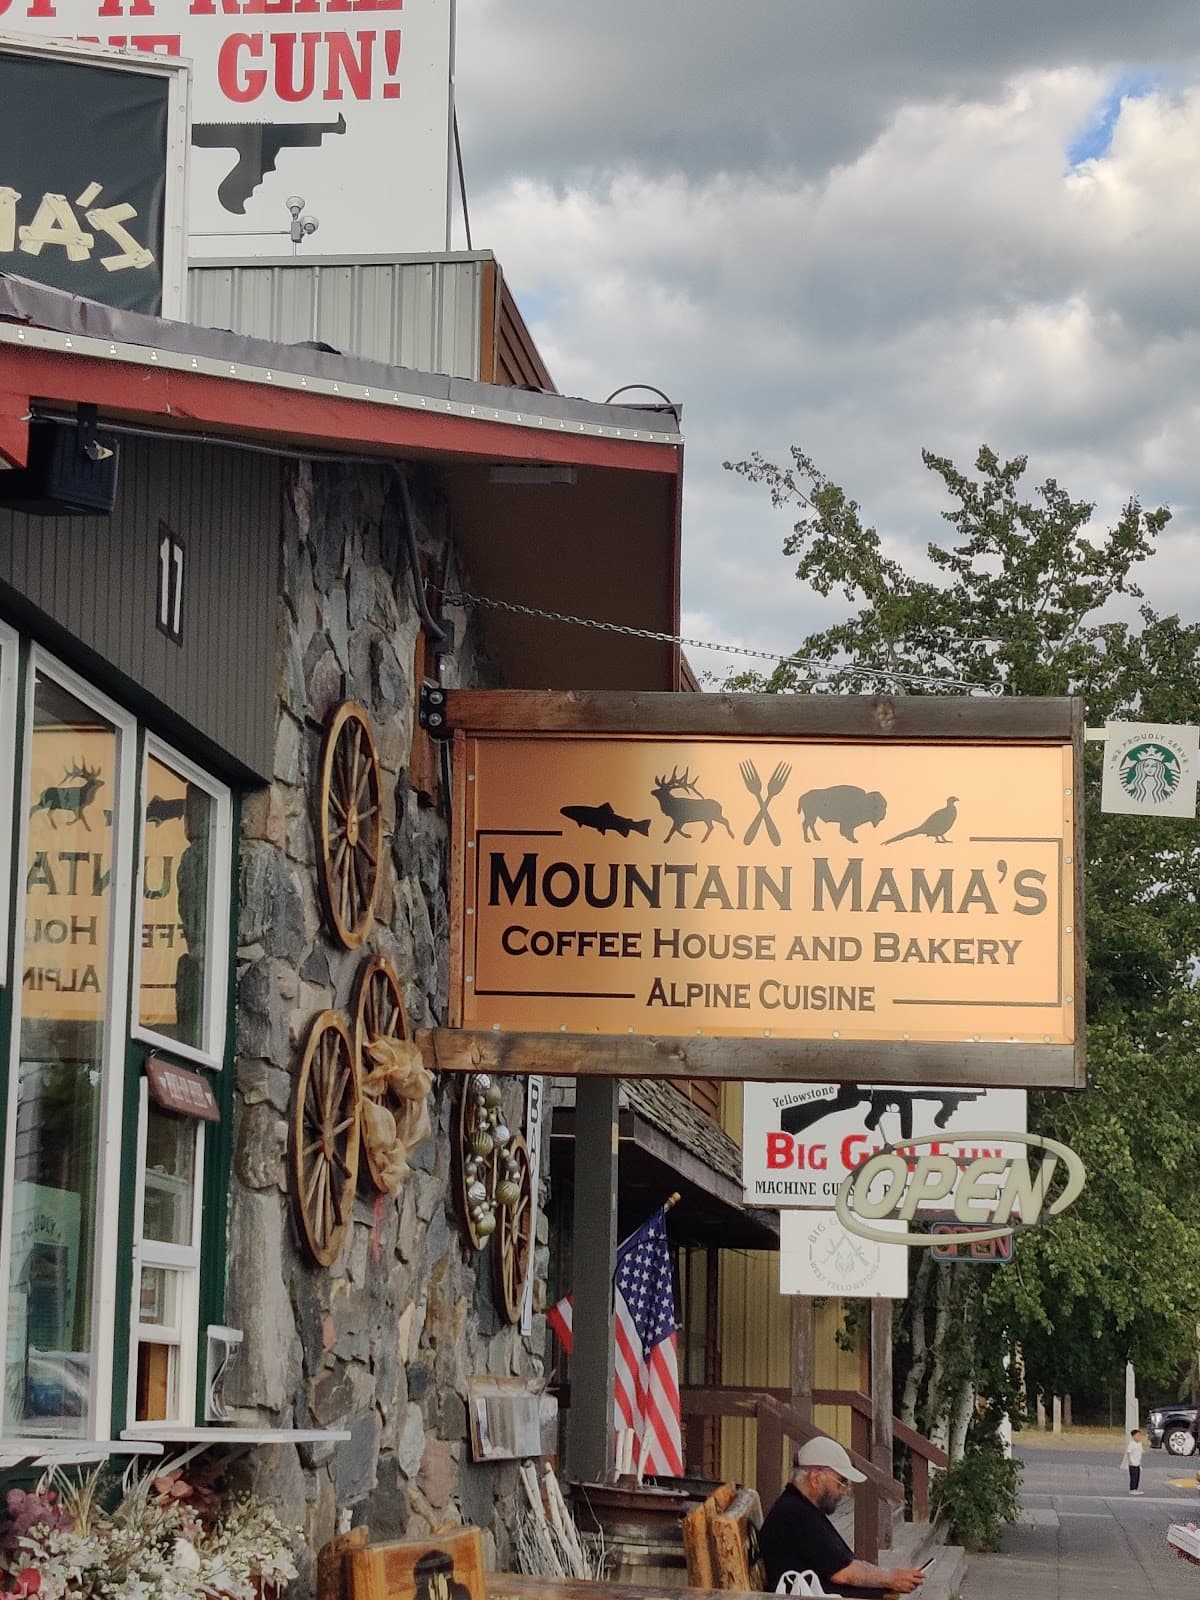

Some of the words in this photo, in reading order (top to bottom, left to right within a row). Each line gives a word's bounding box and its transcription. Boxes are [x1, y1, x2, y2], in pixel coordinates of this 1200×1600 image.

[217, 30, 402, 103] GUN!
[489, 852, 792, 910] MOUNTAIN
[811, 857, 1048, 916] MAMA'S
[502, 925, 642, 958] COFFEE
[653, 928, 776, 961] HOUSE
[786, 935, 862, 963] AND
[873, 932, 1022, 966] BAKERY
[646, 976, 752, 1009] ALPINE
[758, 979, 875, 1012] CUISINE
[772, 1085, 835, 1108] Yellowstone
[766, 1132, 828, 1170] BIG
[755, 1180, 817, 1195] MACHINE
[852, 1154, 1056, 1225] OPEN
[808, 1223, 826, 1245] BIG
